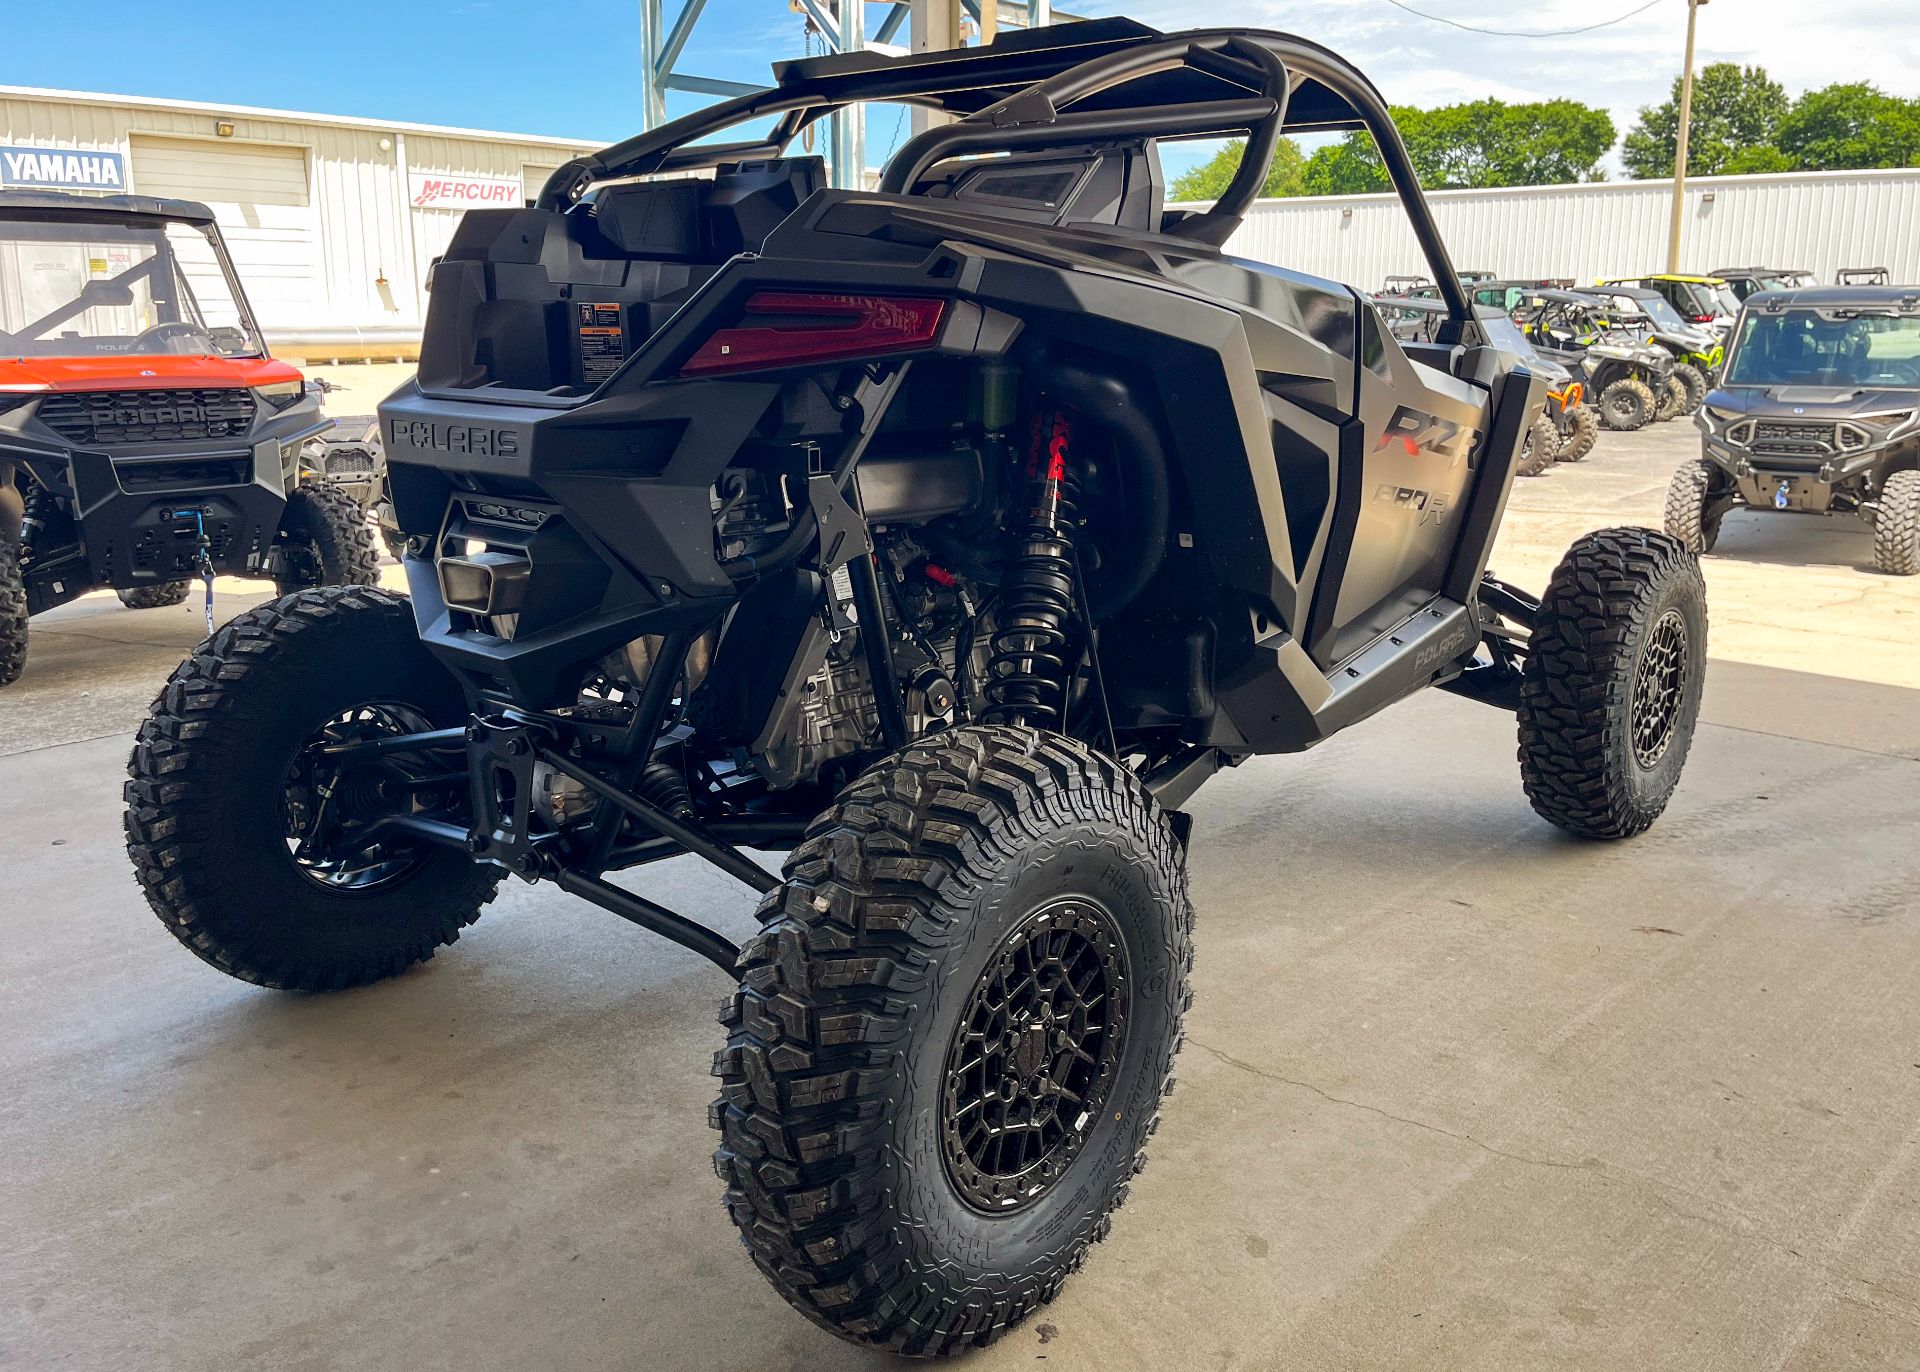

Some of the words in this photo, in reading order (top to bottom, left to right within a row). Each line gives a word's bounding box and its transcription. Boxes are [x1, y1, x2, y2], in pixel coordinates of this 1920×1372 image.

[4, 152, 120, 185] YAMAHA
[414, 180, 517, 205] MERCURY
[91, 405, 224, 425] POLARIS
[390, 419, 518, 459] POLARIS
[1372, 404, 1484, 472] RZR
